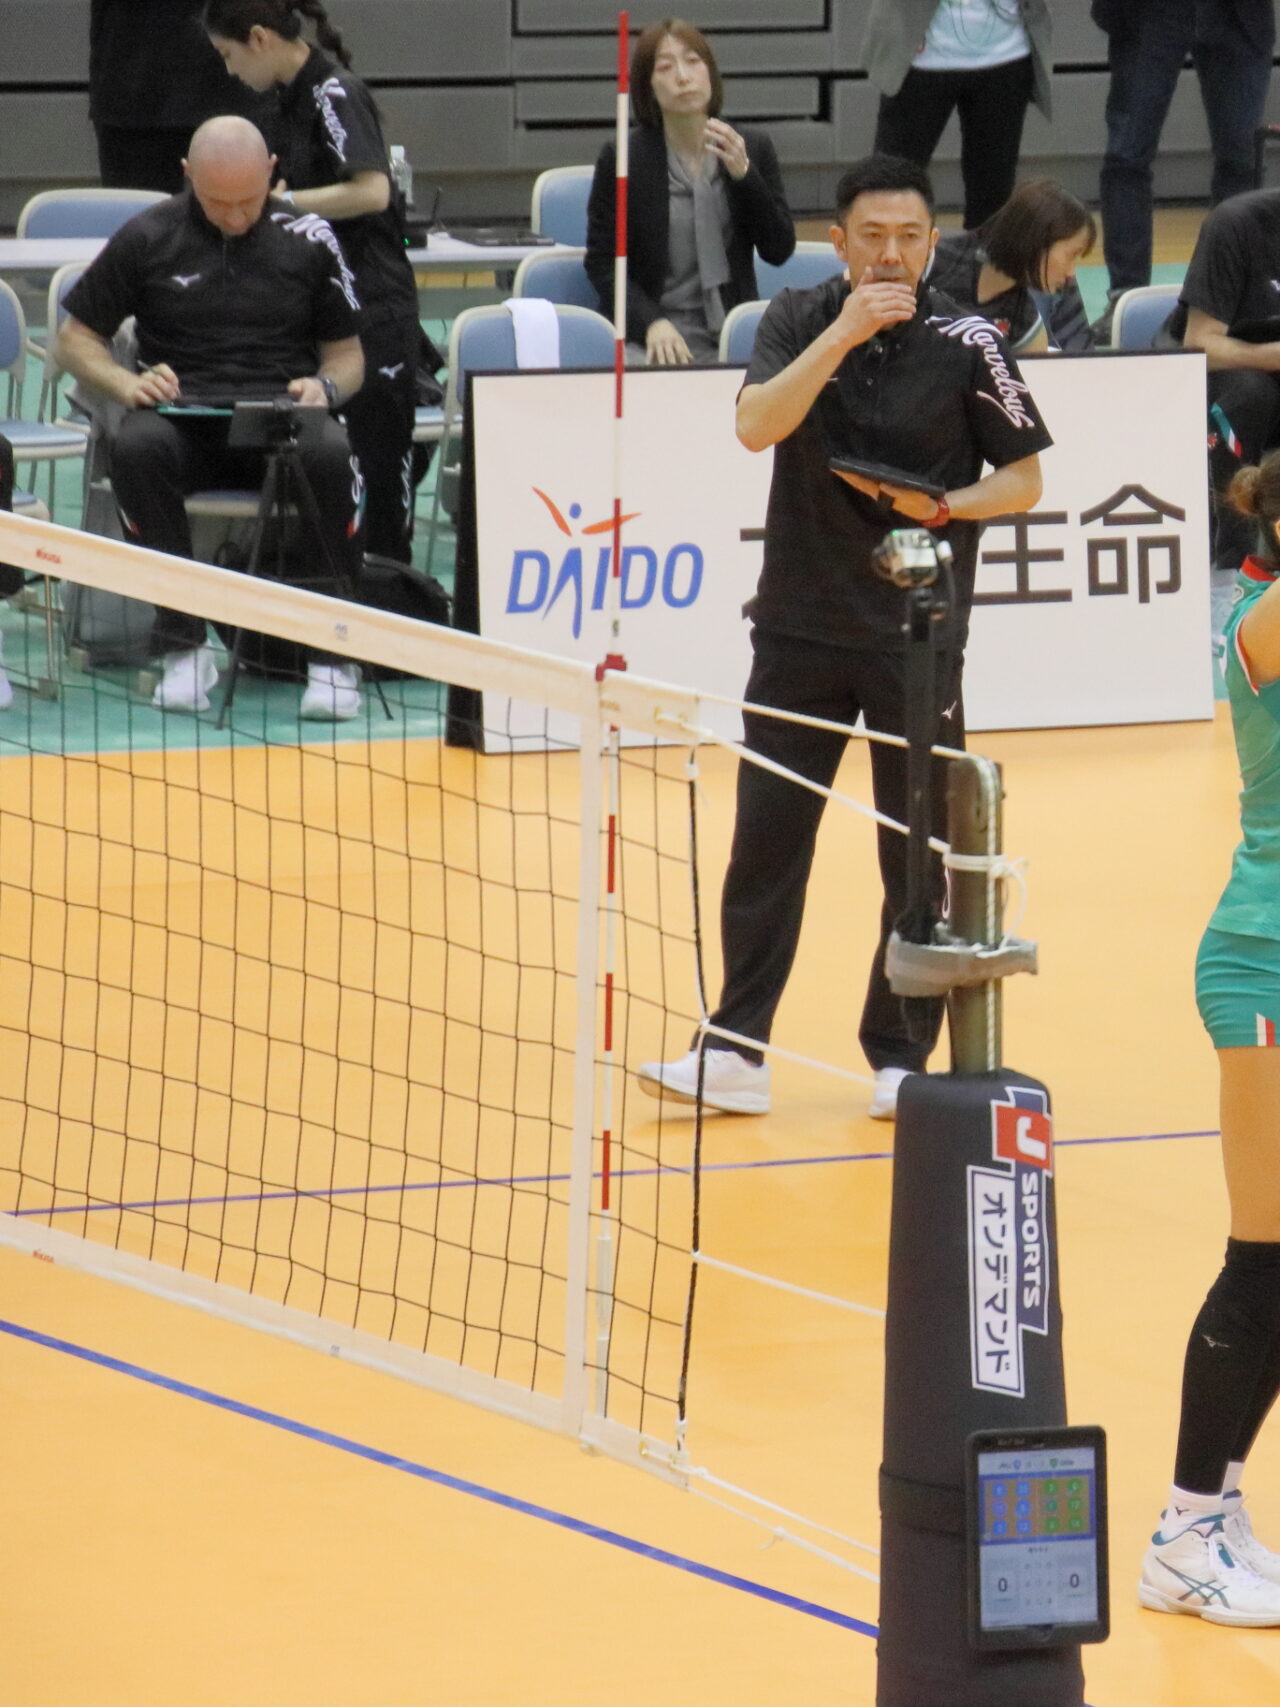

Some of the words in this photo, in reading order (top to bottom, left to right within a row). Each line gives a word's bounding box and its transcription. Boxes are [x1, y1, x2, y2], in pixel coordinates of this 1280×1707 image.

[924, 315, 1035, 428] Marvelous
[505, 543, 704, 638] DAIDO
[1016, 1116, 1046, 1160] J
[982, 1192, 1010, 1374] オンデマンド
[1021, 1171, 1041, 1309] SPORTS
[997, 1577, 1008, 1592] 0
[1069, 1573, 1080, 1588] 0
